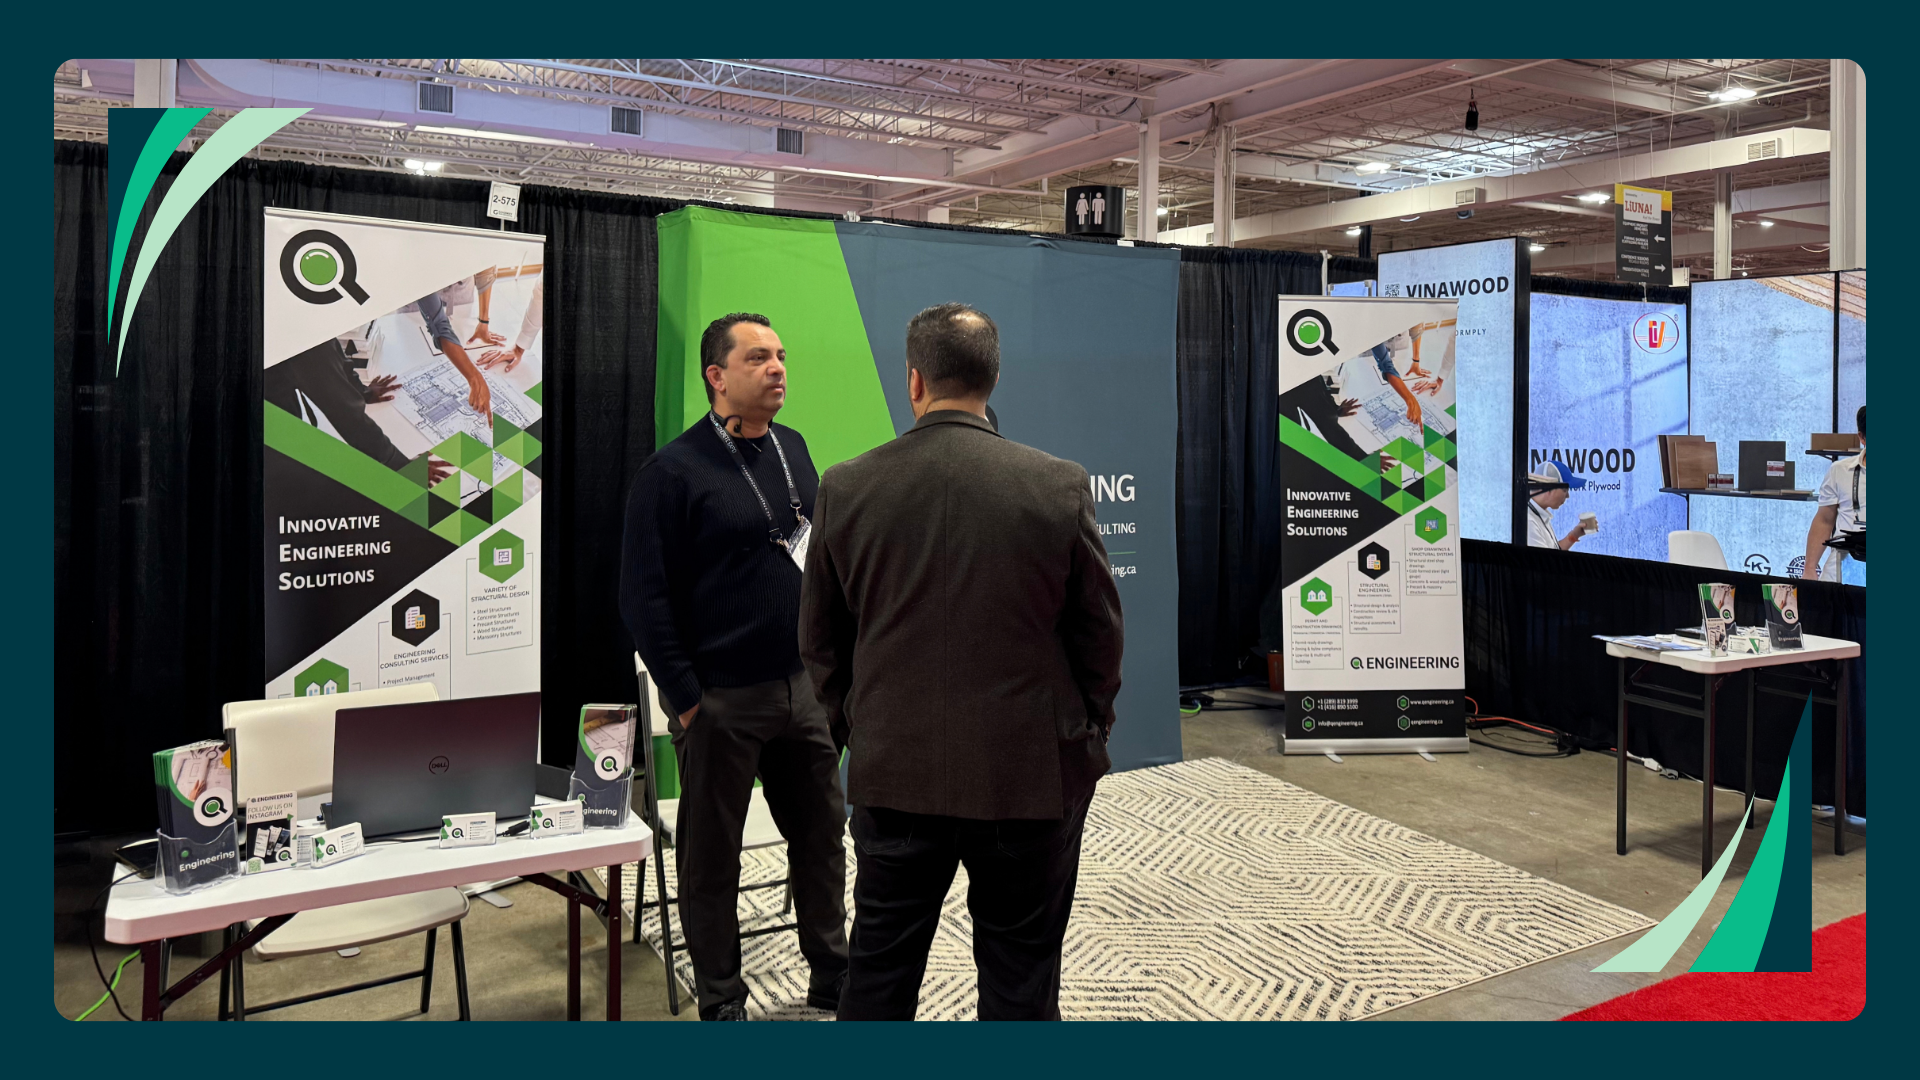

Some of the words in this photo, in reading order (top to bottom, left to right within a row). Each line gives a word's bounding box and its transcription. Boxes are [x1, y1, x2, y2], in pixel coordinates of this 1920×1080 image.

[493, 195, 516, 207] 2-575
[1625, 200, 1653, 215] LiUNA!
[1406, 276, 1509, 298] VINAWOOD
[1588, 480, 1620, 493] Plywood
[1287, 488, 1351, 501] INNOVATIVE
[1287, 506, 1359, 519] ENGINEERING
[279, 516, 380, 534] INNOVATIVE
[1097, 522, 1136, 535] ULTING
[1287, 524, 1348, 537] SOLUTIONS
[279, 541, 391, 563] ENGINEERING
[279, 570, 375, 591] SOLUTIONS
[510, 590, 530, 598] DESIGN
[394, 648, 436, 659] ENGINEERING
[380, 658, 419, 669] CONSULTING
[421, 654, 449, 663] SERVICES
[1367, 656, 1460, 670] ENGINEERING
[387, 676, 404, 685] Project
[257, 793, 294, 803] ENGINEERING
[248, 804, 273, 814] FOLLOW
[248, 810, 283, 820] INSTAGRAM
[180, 850, 235, 873] Engineering
